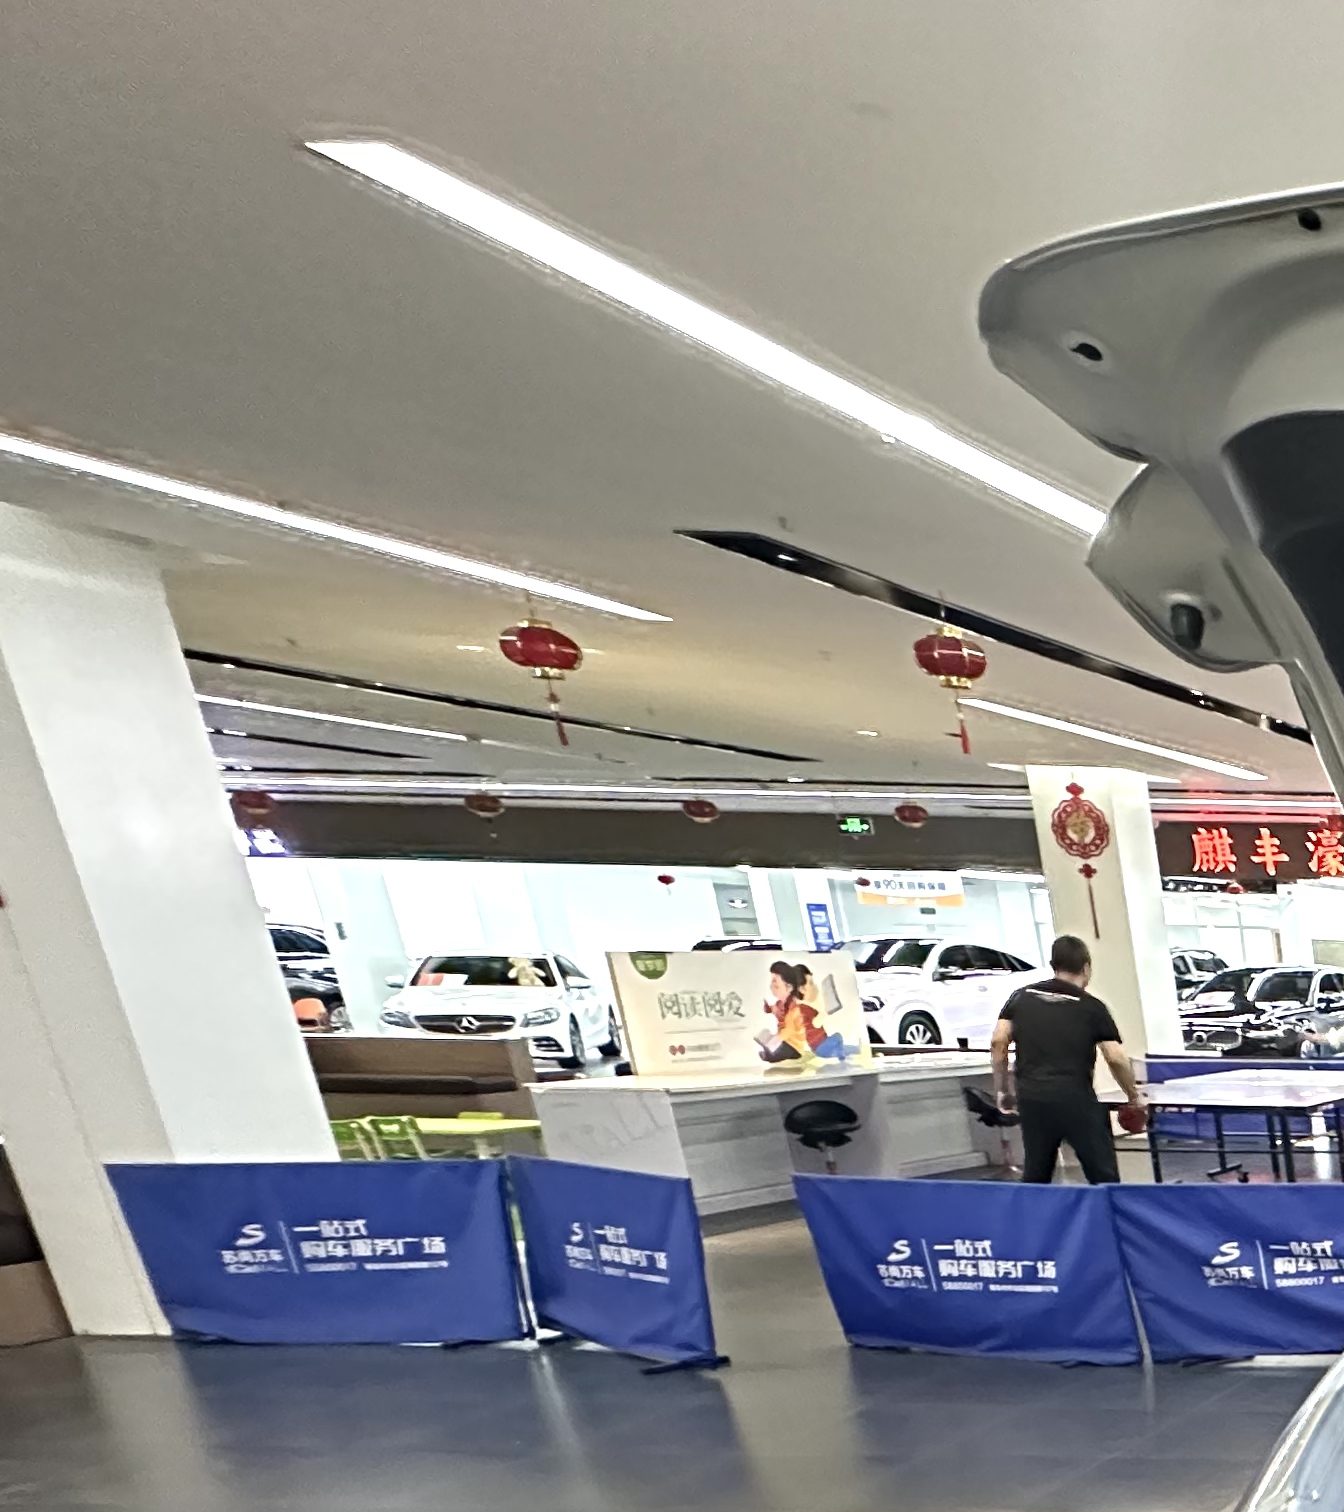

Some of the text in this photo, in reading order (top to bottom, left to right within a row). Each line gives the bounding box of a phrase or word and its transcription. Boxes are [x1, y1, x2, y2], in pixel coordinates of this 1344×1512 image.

[933, 1239, 992, 1257] 一站式
[1269, 1240, 1333, 1257] 一站式
[938, 1259, 1056, 1279] 购车服务广场
